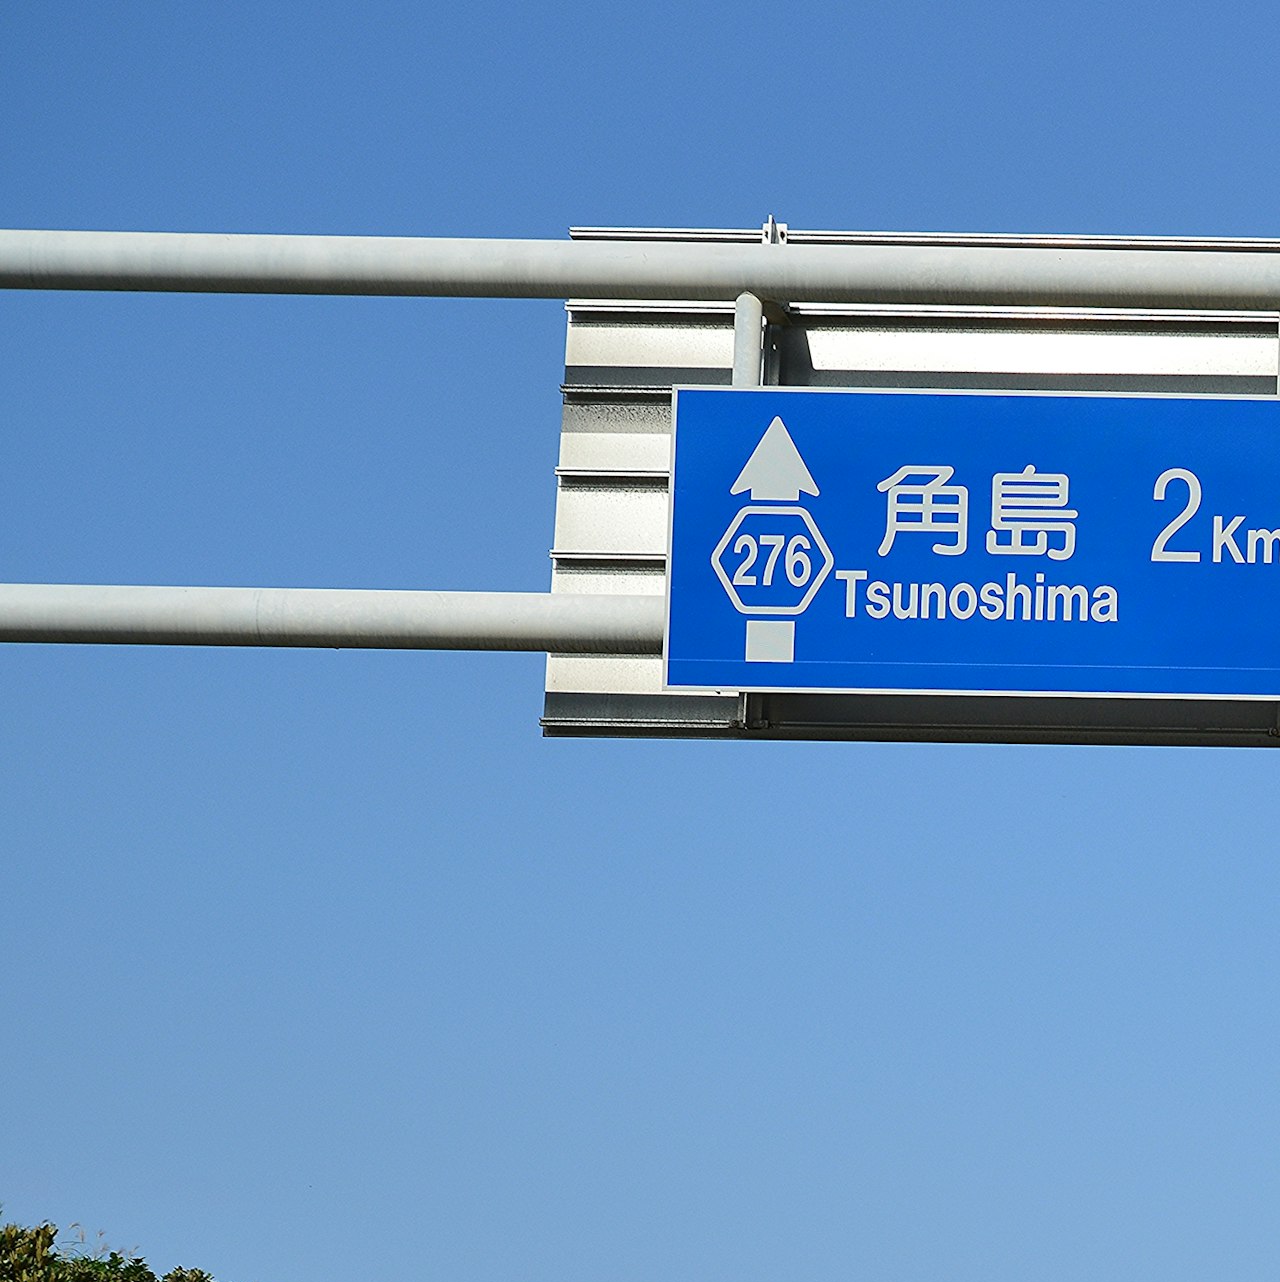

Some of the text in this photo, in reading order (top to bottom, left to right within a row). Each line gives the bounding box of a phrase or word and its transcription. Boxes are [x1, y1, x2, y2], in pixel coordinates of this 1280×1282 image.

[876, 464, 1079, 561] 角島
[732, 534, 812, 588] 276
[835, 569, 1119, 623] Tsunoshima
